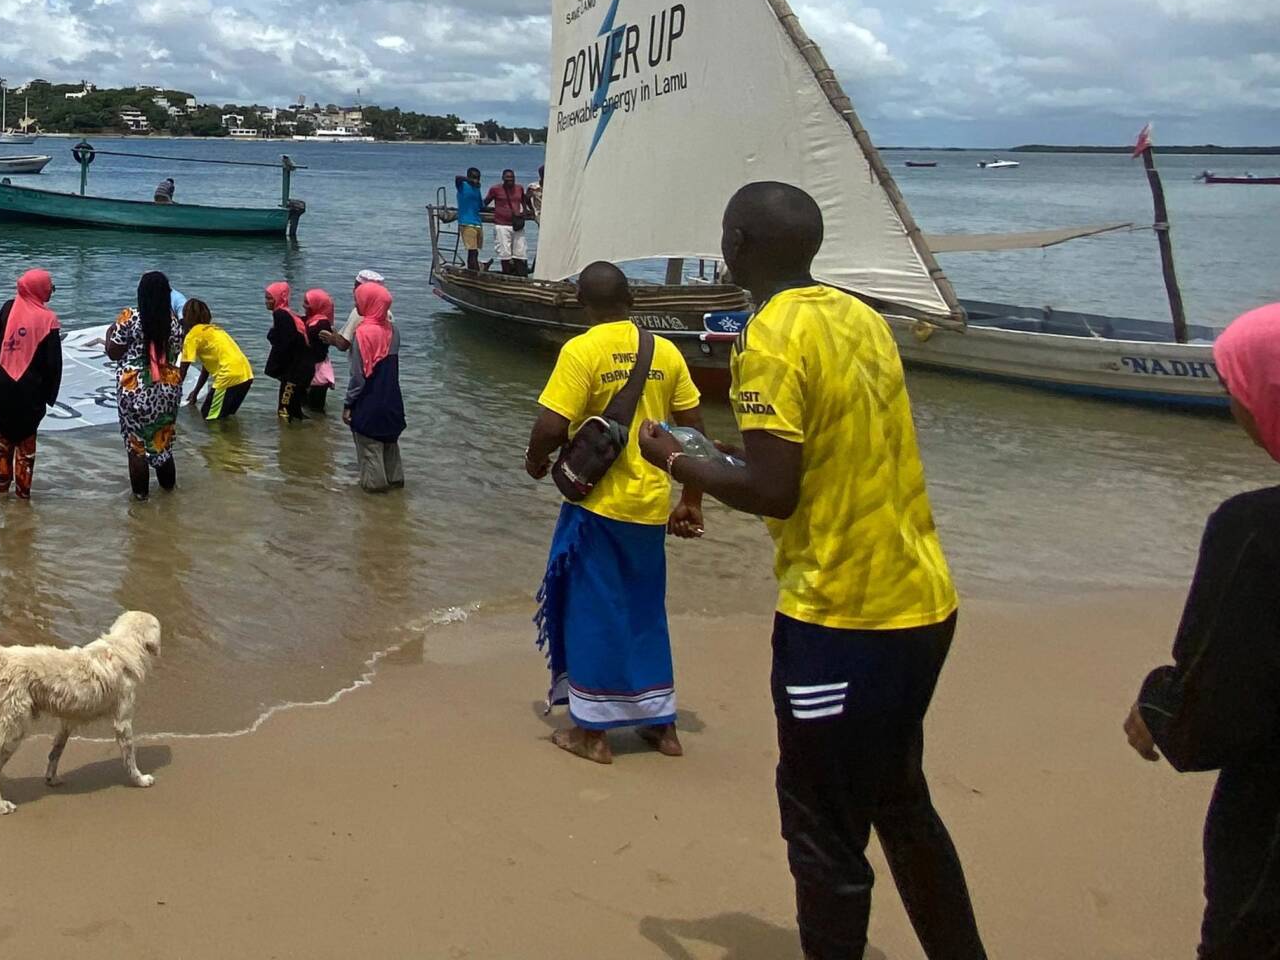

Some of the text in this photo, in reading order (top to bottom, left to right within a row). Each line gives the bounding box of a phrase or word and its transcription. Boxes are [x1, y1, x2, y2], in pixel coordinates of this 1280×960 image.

[559, 3, 686, 106] POWER UP
[557, 71, 688, 134] Renewable energy in Lamu
[612, 352, 639, 364] POWE
[1122, 356, 1216, 379] NADH
[739, 391, 761, 402] ISIT
[735, 403, 778, 416] ANDA
